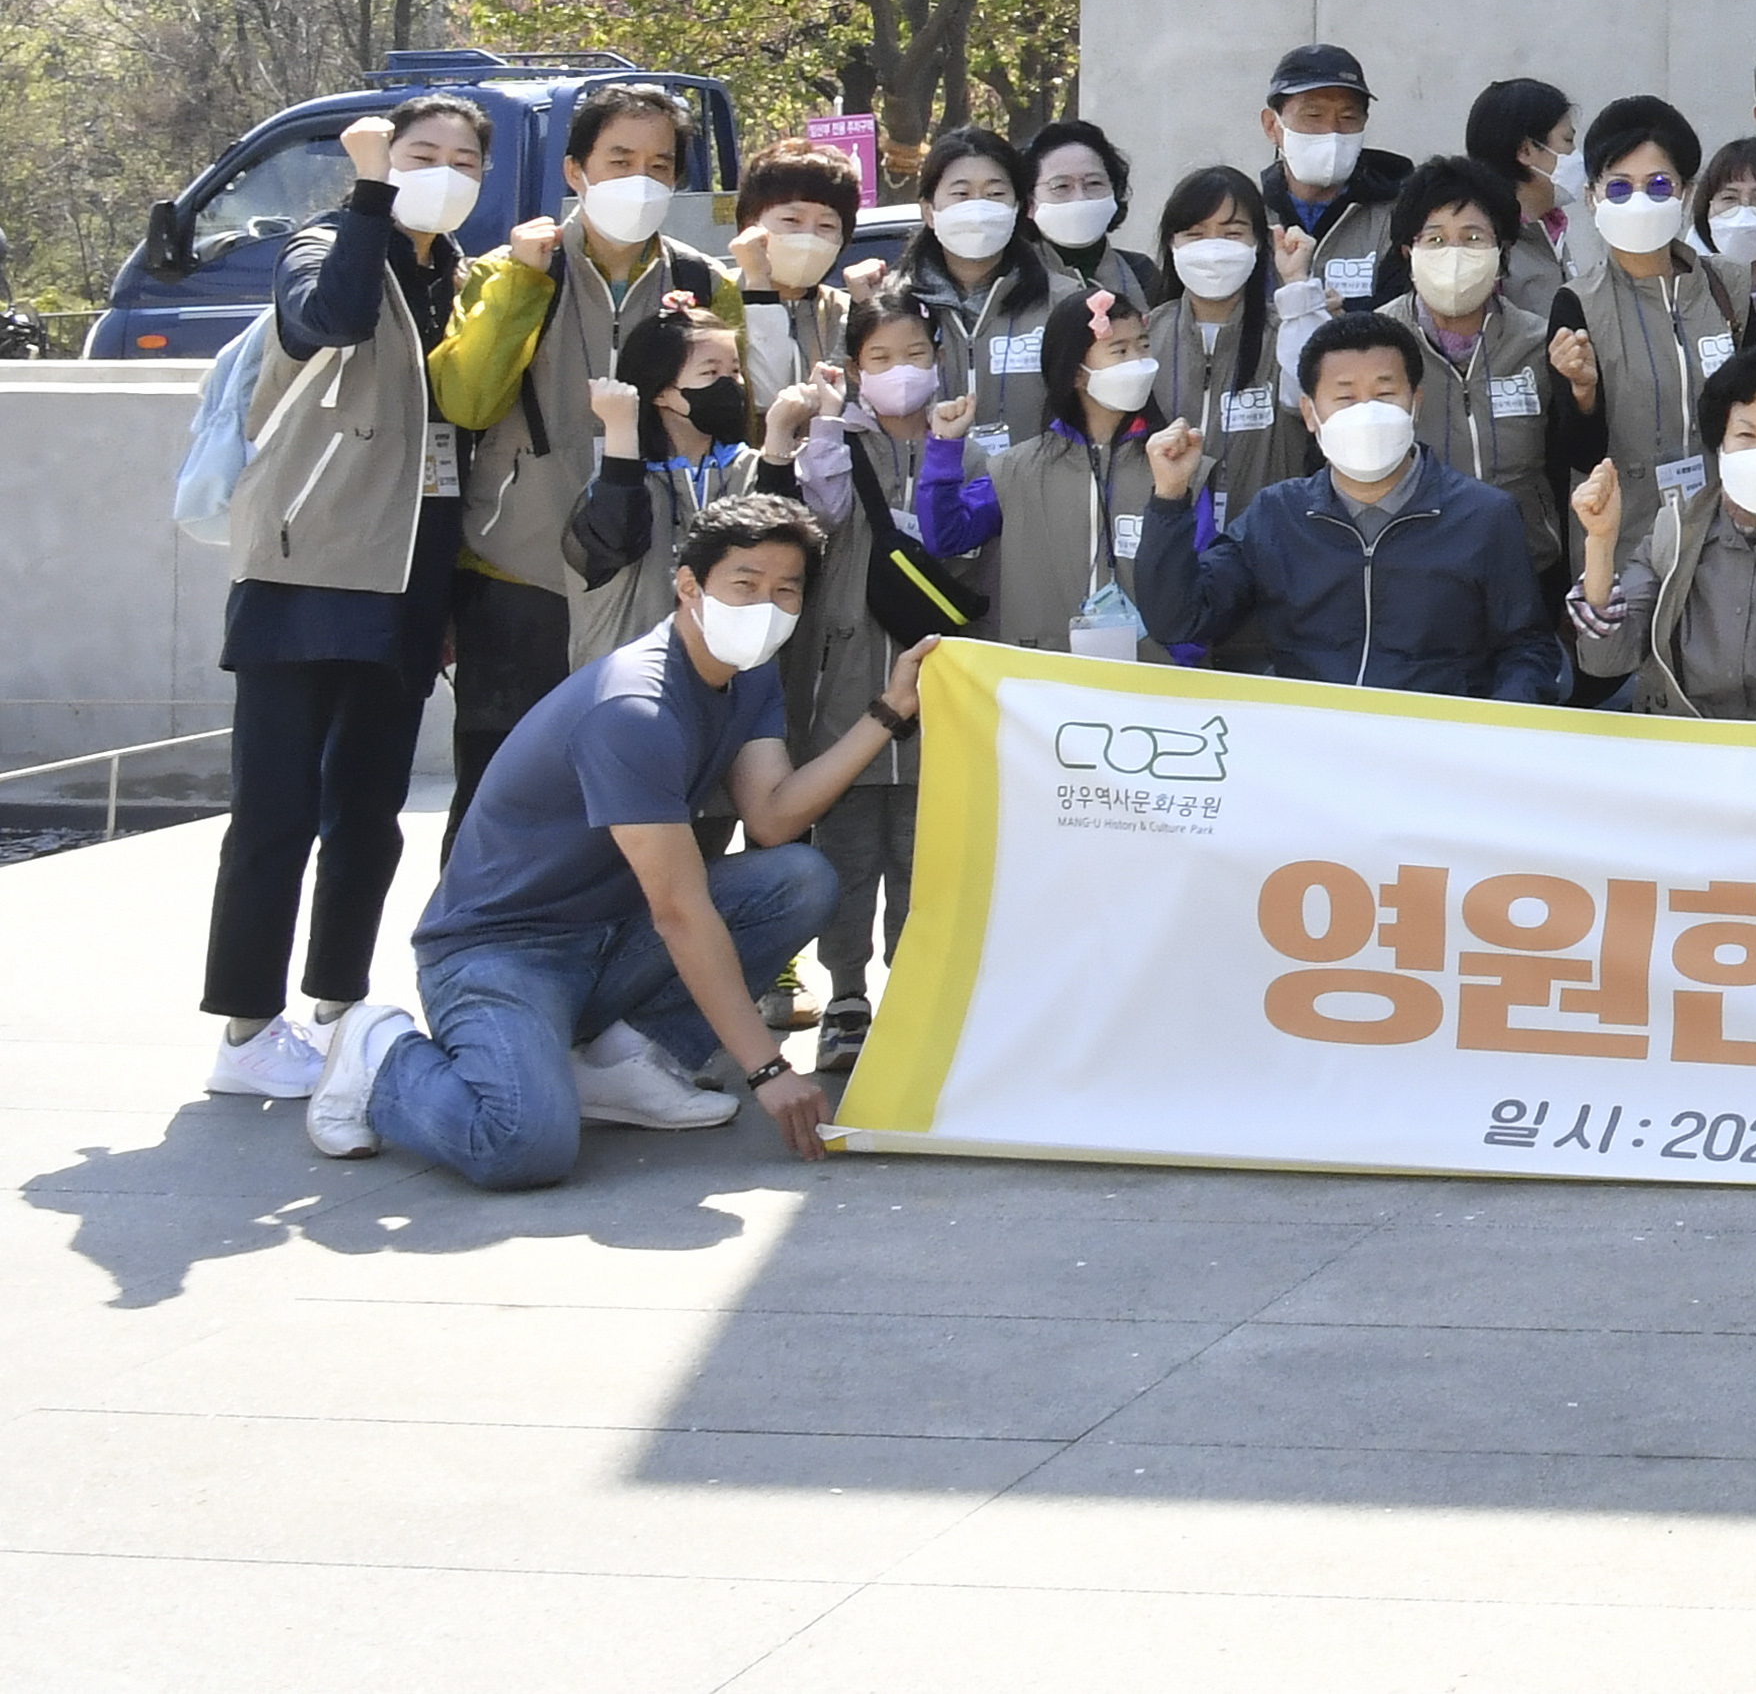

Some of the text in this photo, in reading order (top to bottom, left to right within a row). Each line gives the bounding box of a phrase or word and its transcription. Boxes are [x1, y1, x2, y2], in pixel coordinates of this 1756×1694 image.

[1057, 785, 1222, 819] 망우역사문화공원
[1057, 816, 1101, 829] MANG-U
[1104, 817, 1136, 832] History
[1149, 820, 1186, 834] Culture
[1189, 824, 1214, 835] Park
